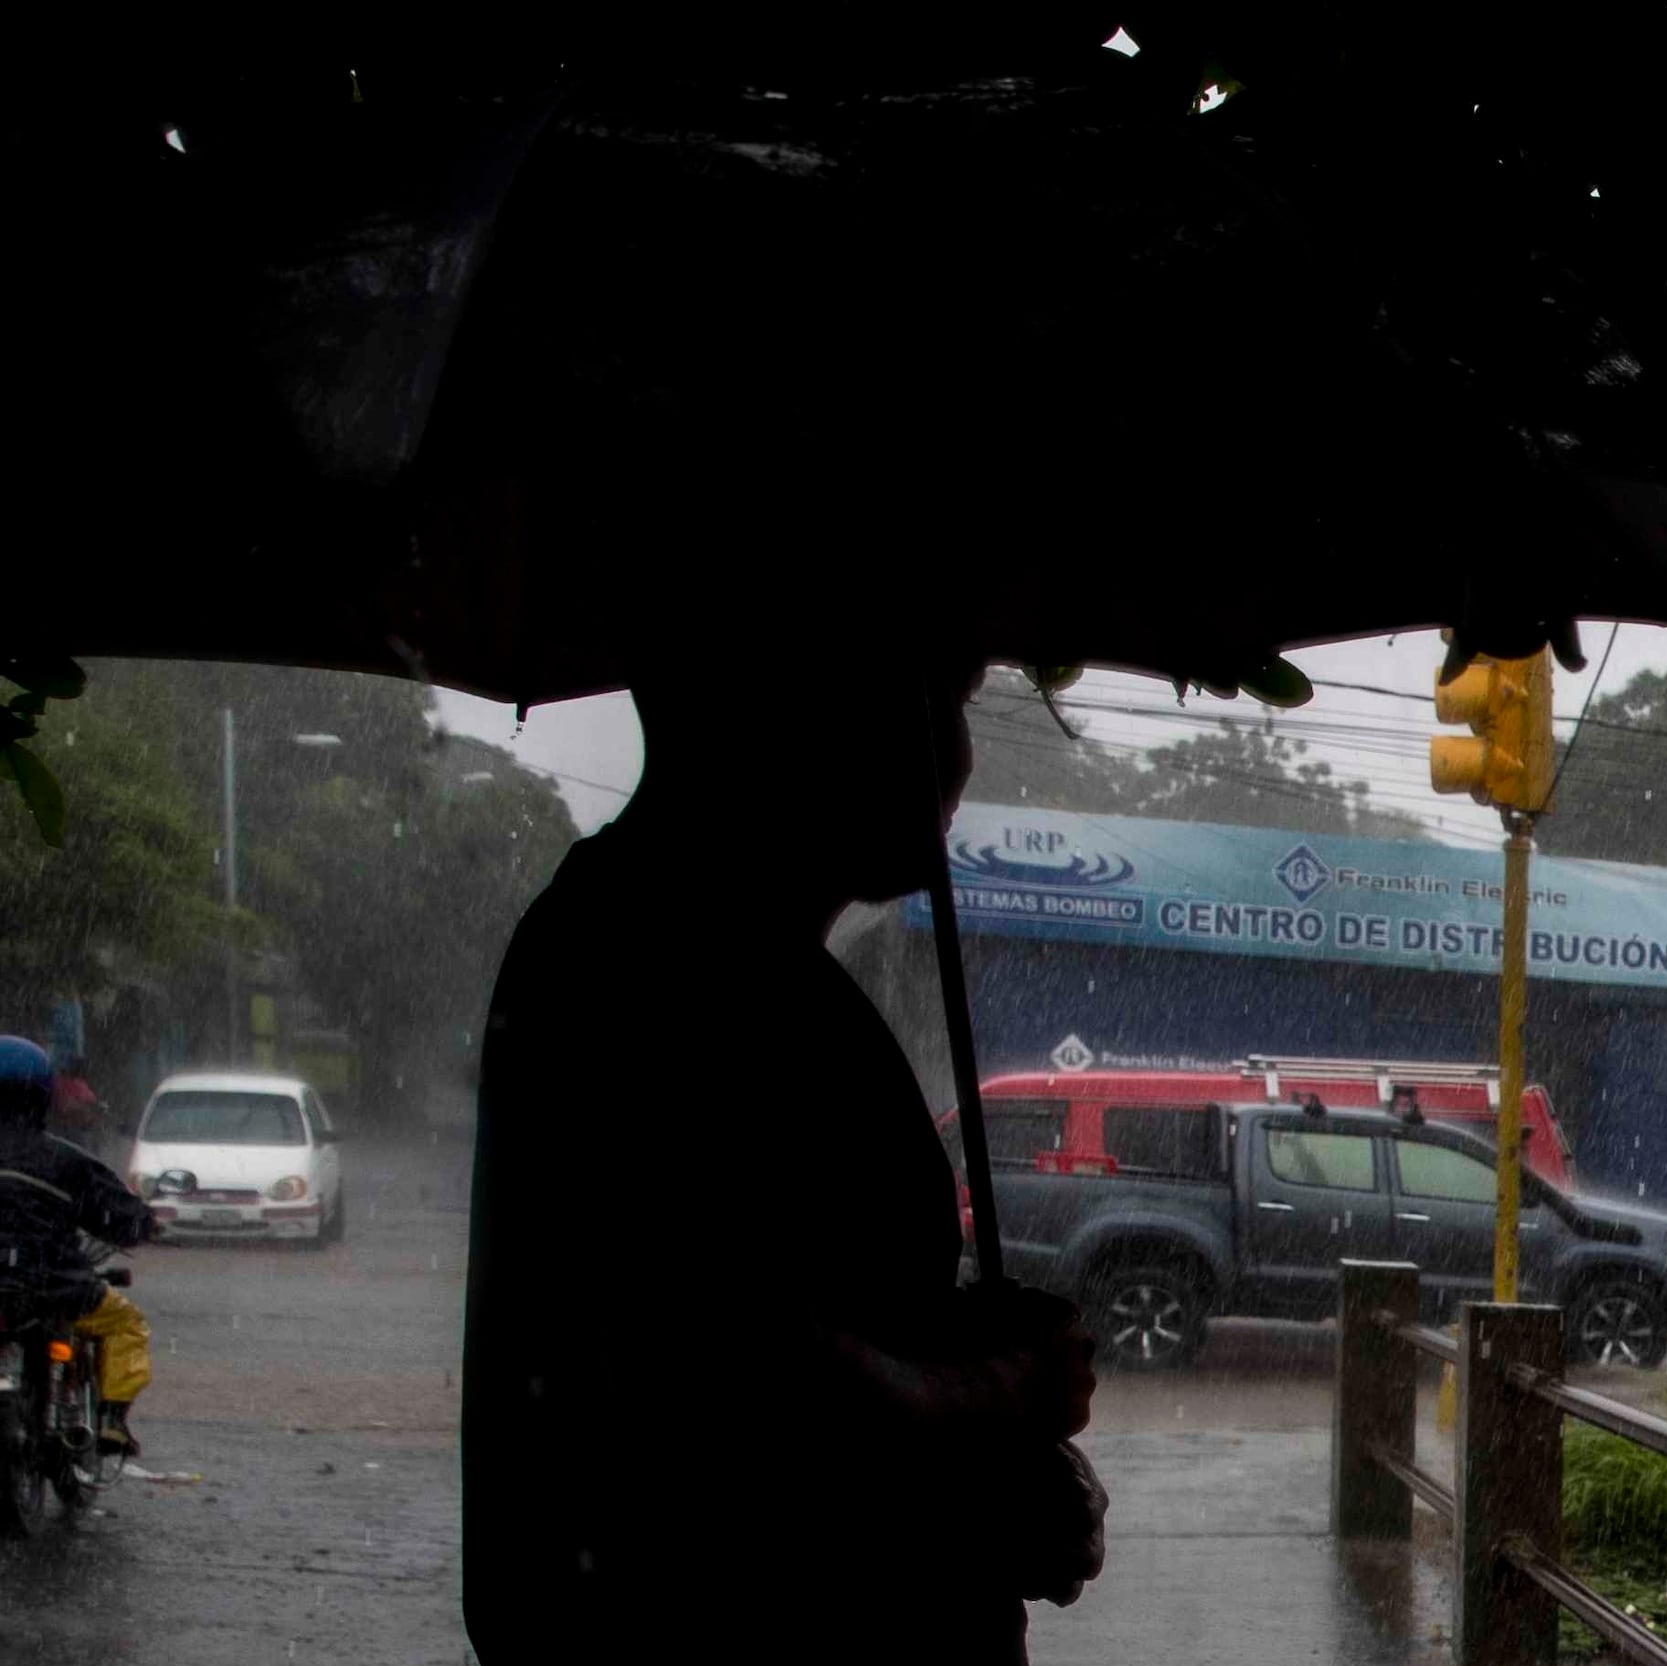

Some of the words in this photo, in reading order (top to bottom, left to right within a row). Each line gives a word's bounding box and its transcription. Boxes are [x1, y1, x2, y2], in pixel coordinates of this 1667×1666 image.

[1002, 827, 1065, 854] URP
[952, 887, 1038, 913] STEMAS
[1043, 896, 1137, 920] BOMBEO
[1337, 868, 1449, 896] Franklin
[1462, 880, 1567, 906] Eleric
[1159, 900, 1324, 942] CENTRO
[1339, 915, 1387, 947] DE
